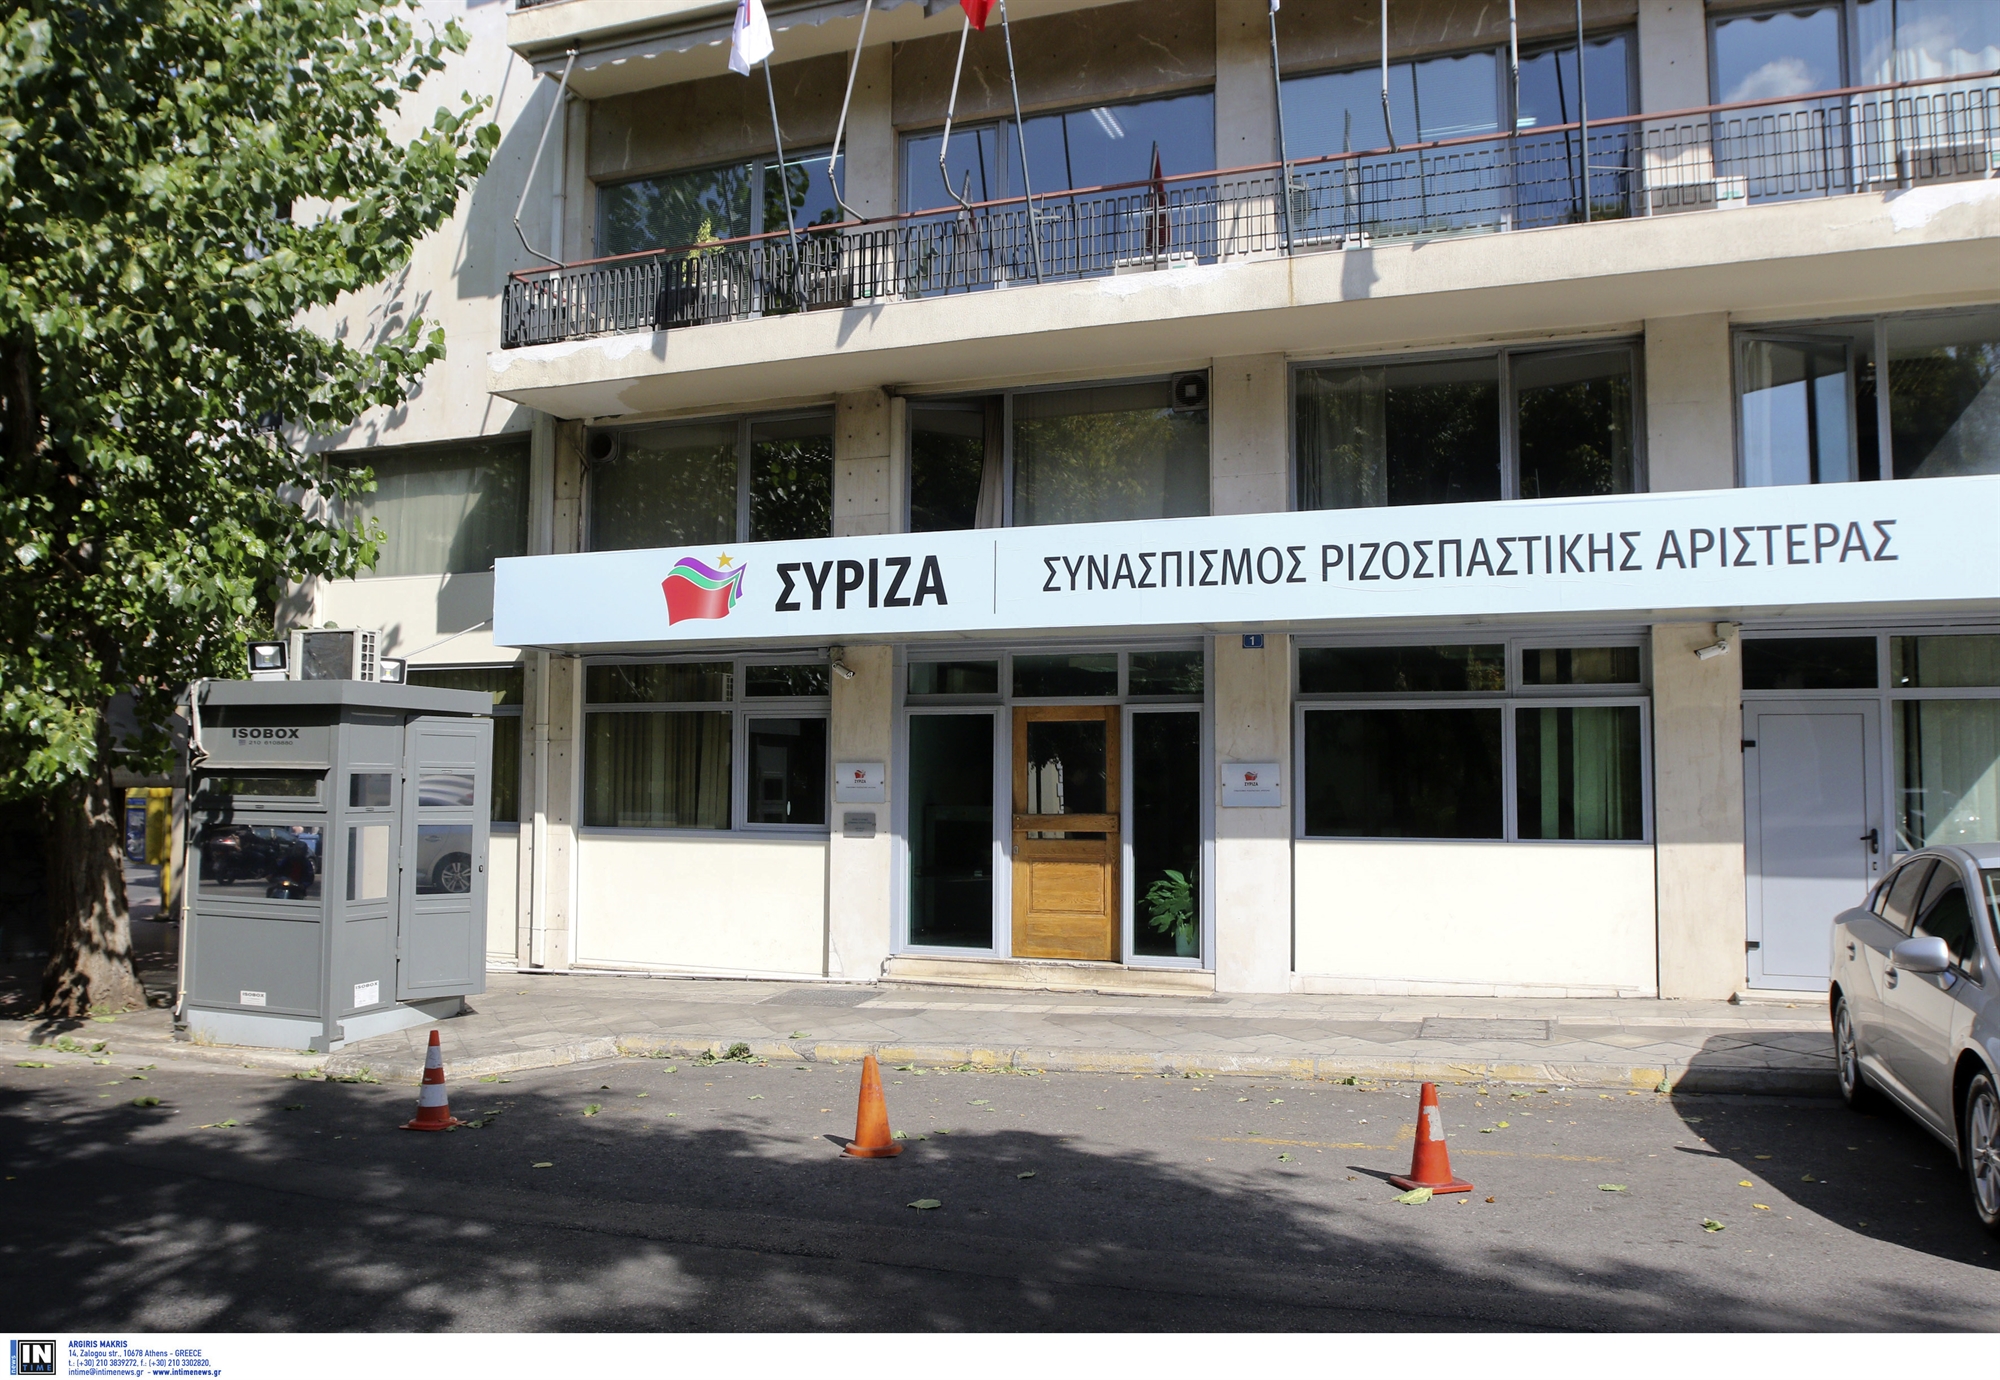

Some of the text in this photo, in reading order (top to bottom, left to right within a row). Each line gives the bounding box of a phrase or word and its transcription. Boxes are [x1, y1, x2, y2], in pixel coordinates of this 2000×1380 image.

[1043, 520, 1898, 592] ΣΥΝΑΣΠΙΣΜΟΣ ΡΙΖΟΣΠΑΣΤΙΚΗΣ ΑΡΙΣΤΕΡΑΣ
[776, 555, 948, 612] ΣΥΡΙΖΑ
[1250, 635, 1255, 646] 1
[232, 728, 300, 739] ISOBOX
